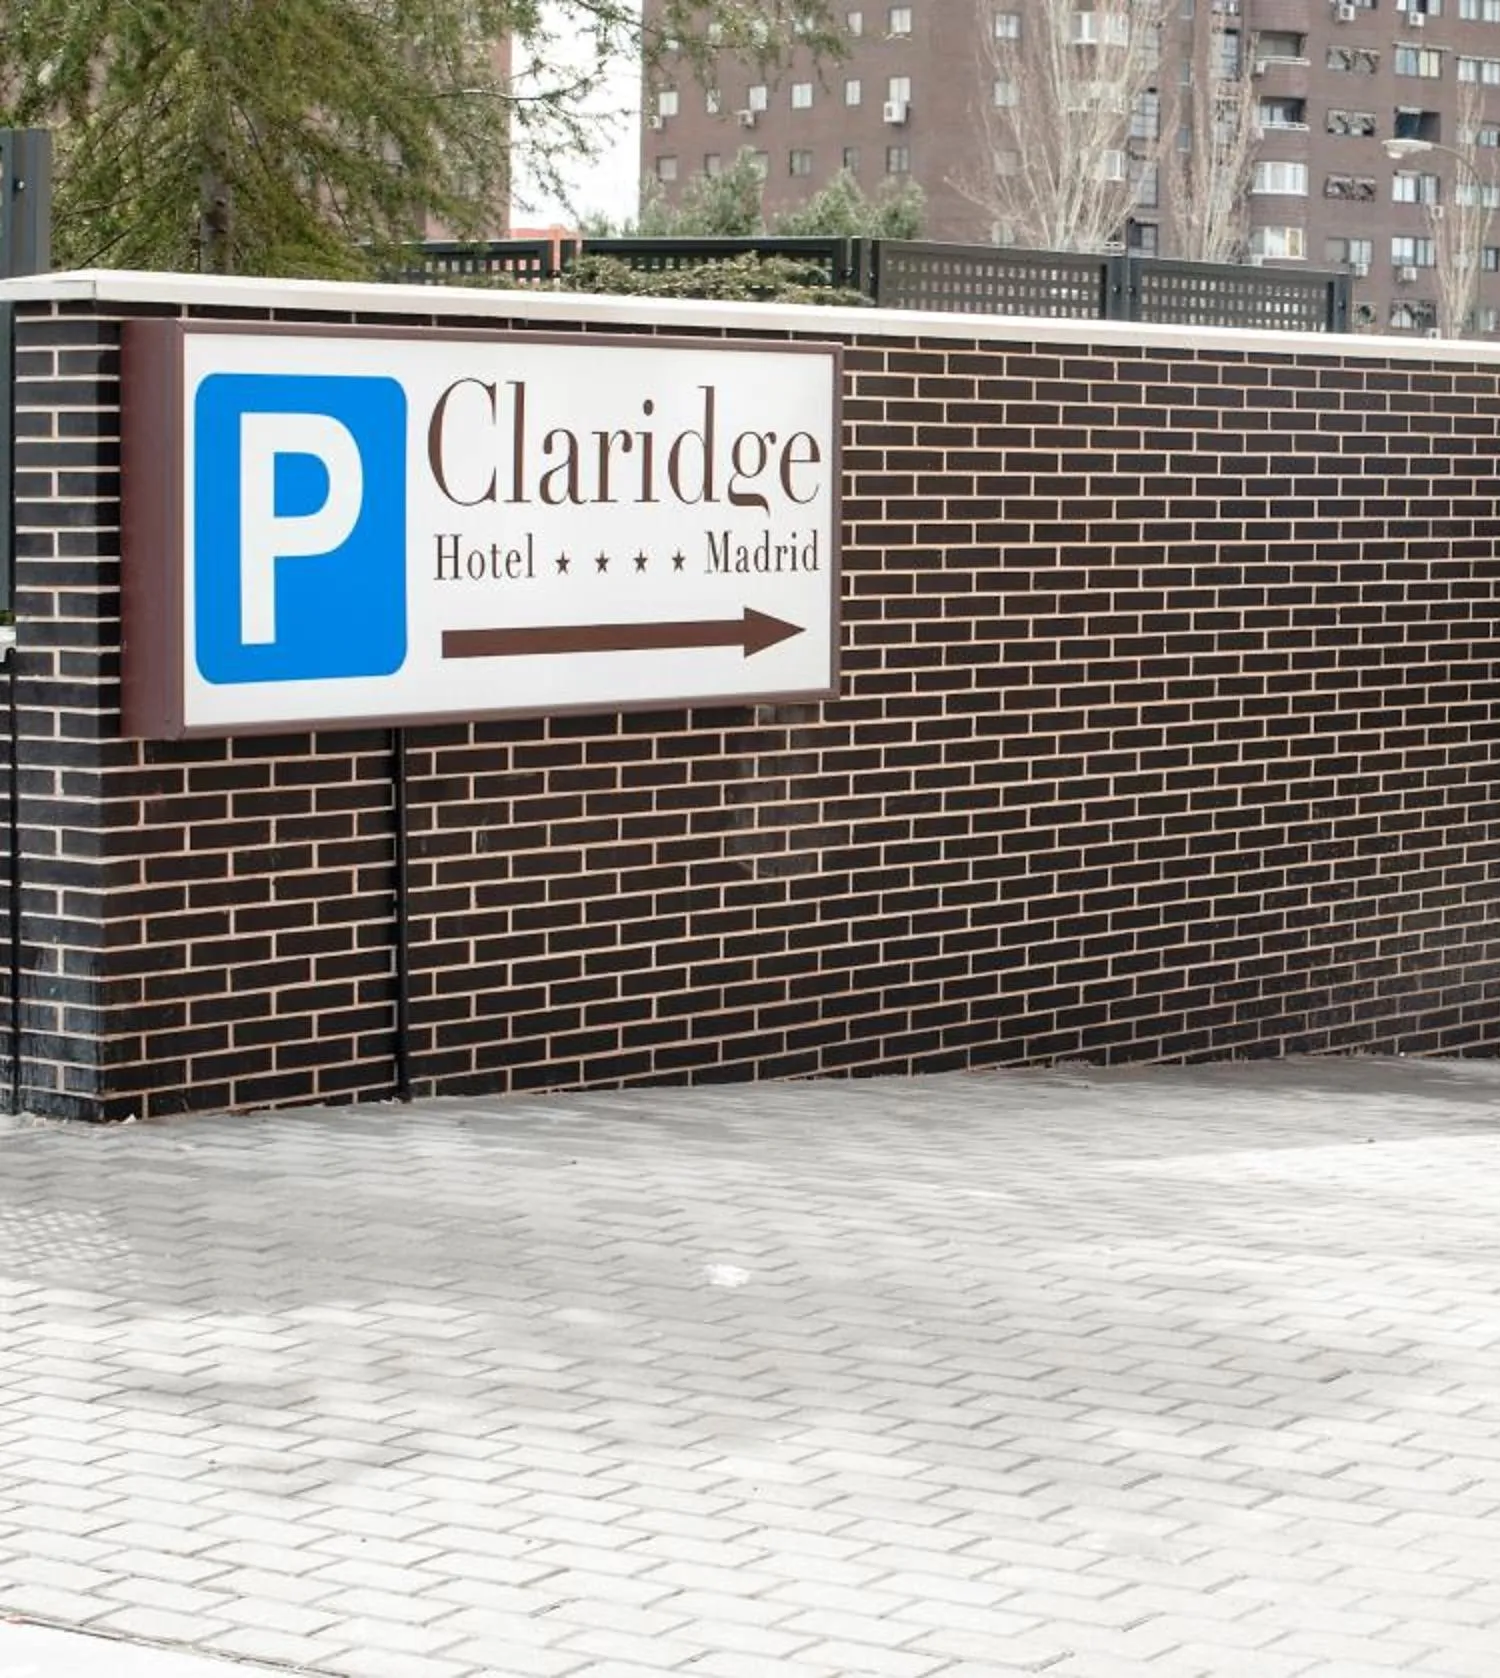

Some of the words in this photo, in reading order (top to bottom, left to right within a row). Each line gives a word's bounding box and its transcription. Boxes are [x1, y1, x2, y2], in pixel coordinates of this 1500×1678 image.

[427, 378, 821, 516] Claridge
[241, 413, 362, 643] P
[435, 533, 533, 580] Hotel
[707, 530, 819, 572] Madrid
